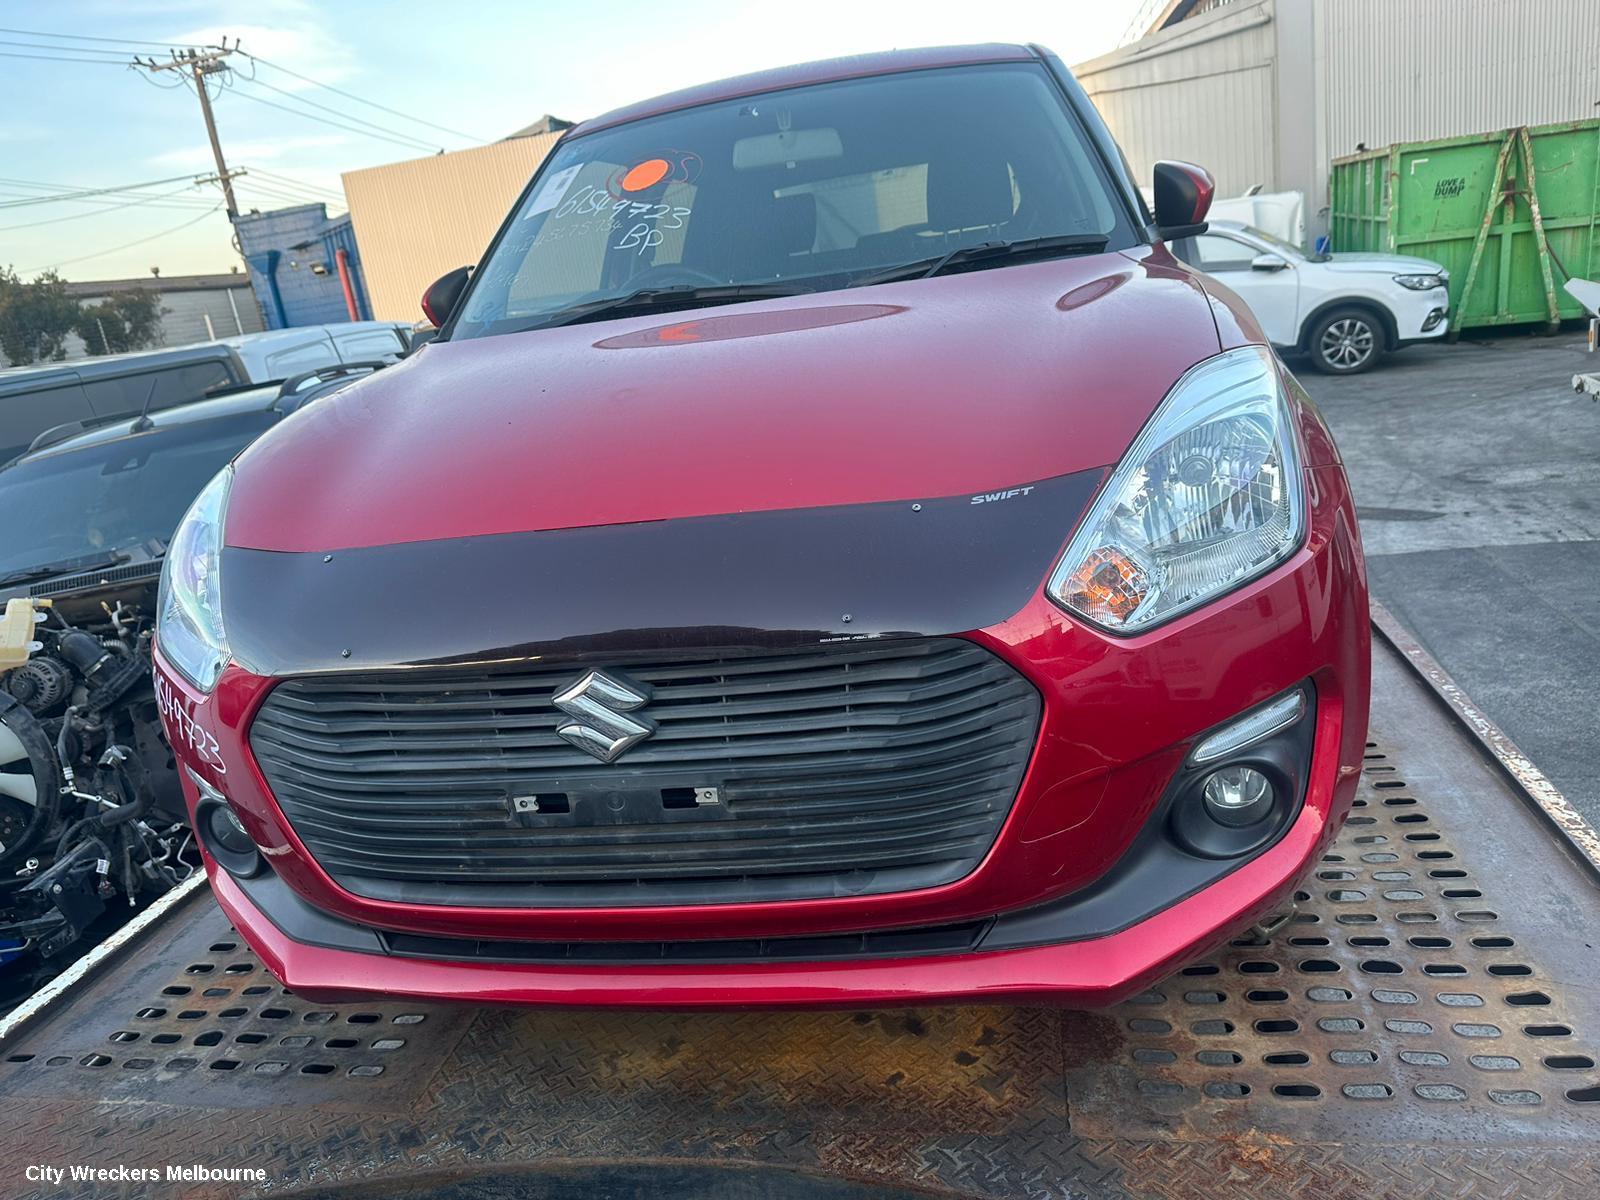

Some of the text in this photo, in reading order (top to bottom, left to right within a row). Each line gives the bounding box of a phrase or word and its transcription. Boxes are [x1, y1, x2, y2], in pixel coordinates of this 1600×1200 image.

[1436, 177, 1459, 187] LOVE
[1434, 184, 1465, 197] DUMP
[970, 485, 1035, 505] SWIFT
